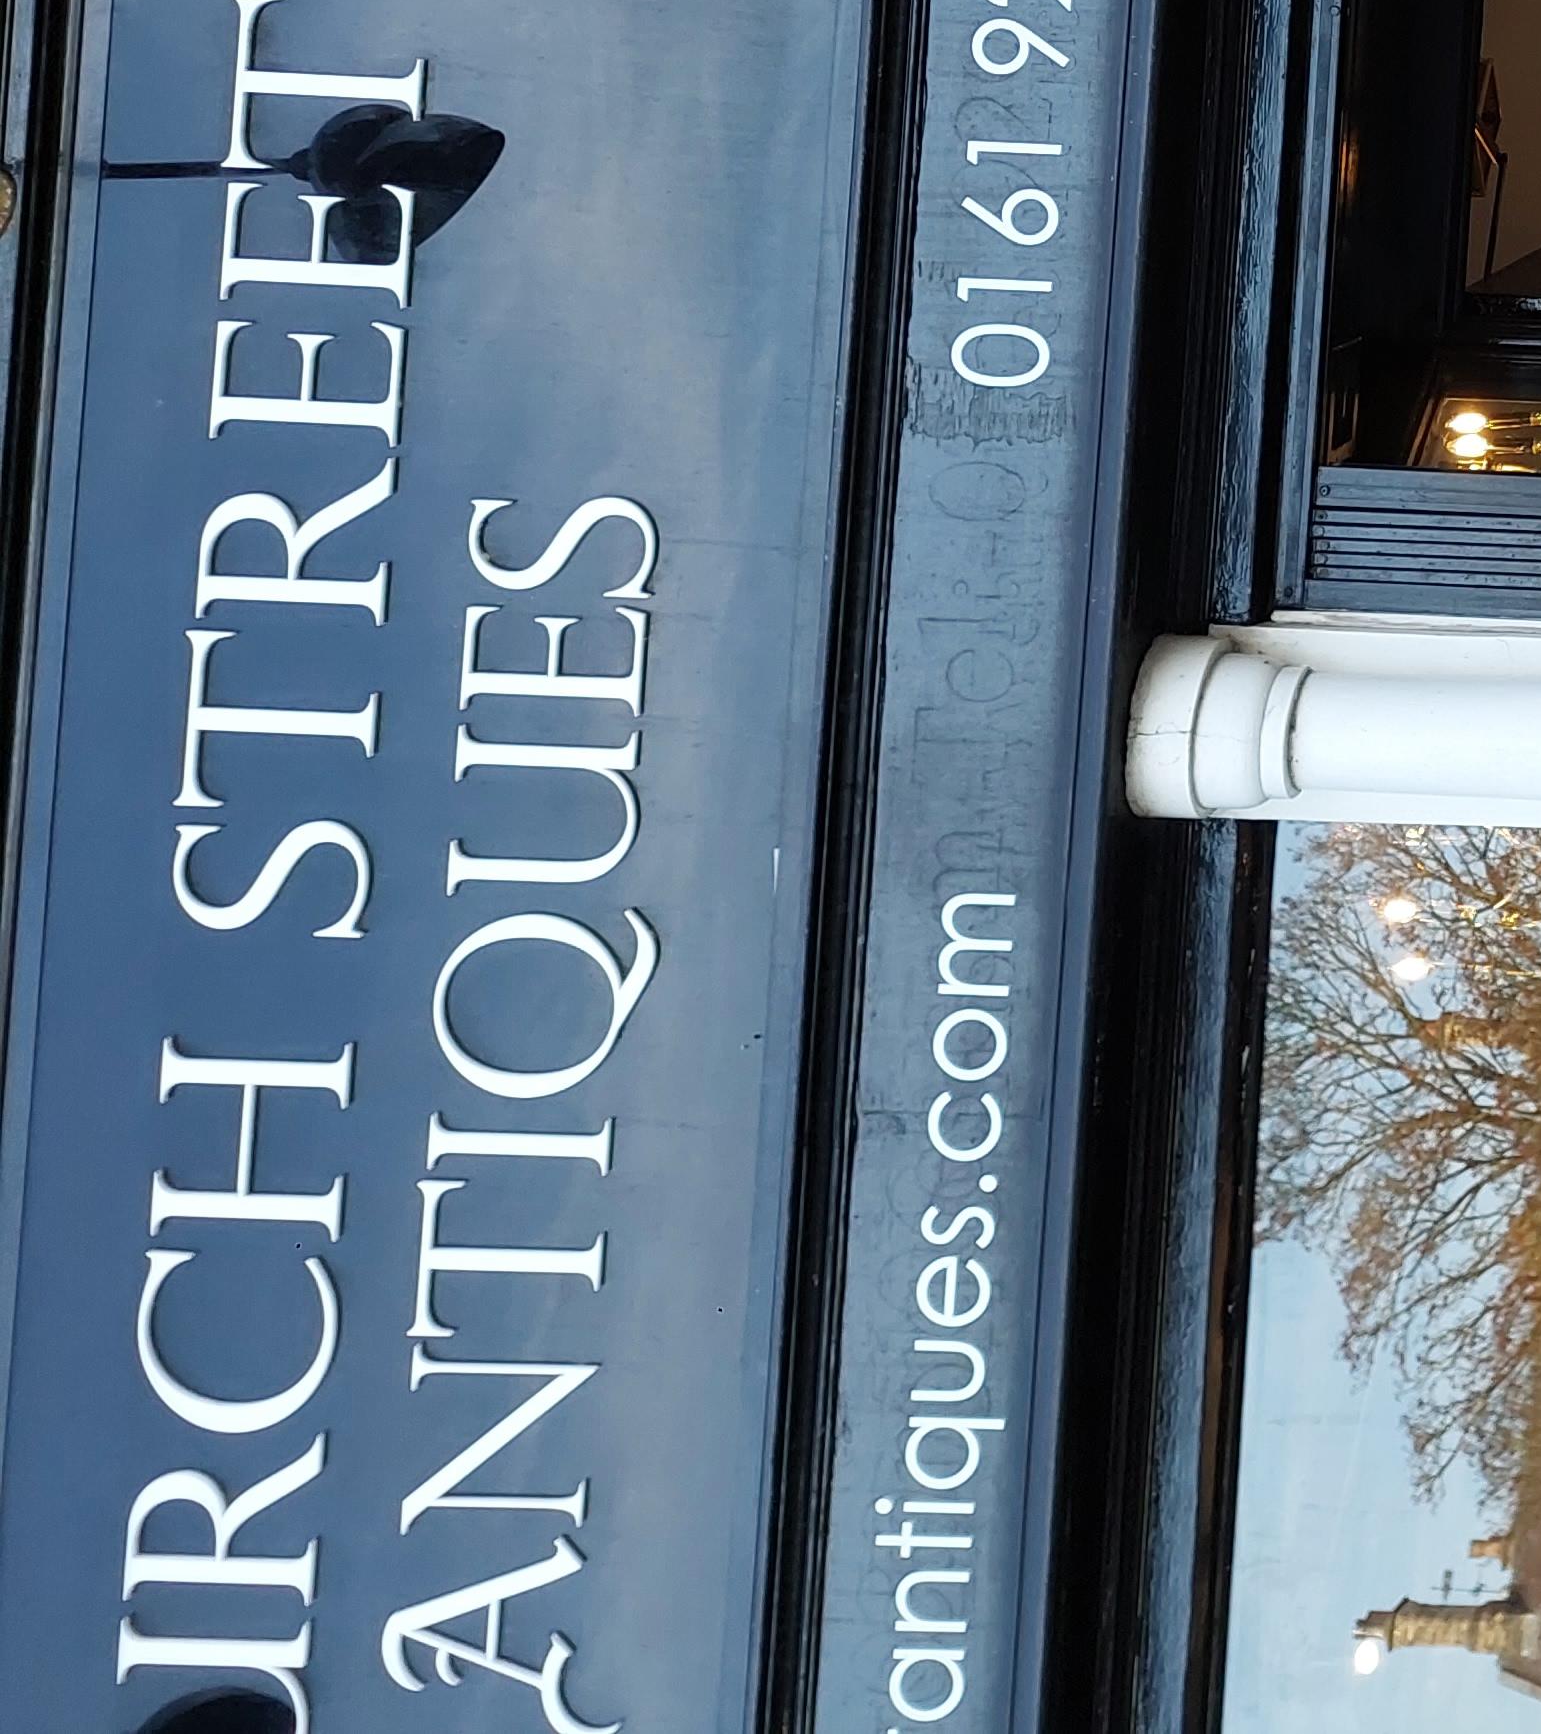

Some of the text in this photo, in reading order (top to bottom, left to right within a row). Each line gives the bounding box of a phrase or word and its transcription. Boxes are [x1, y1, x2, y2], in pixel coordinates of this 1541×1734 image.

[117, 1039, 351, 1734] URCH
[381, 496, 657, 1734] ANTIQUES
[873, 892, 1018, 1734] antiques.com
[949, 139, 1063, 388] 0161
